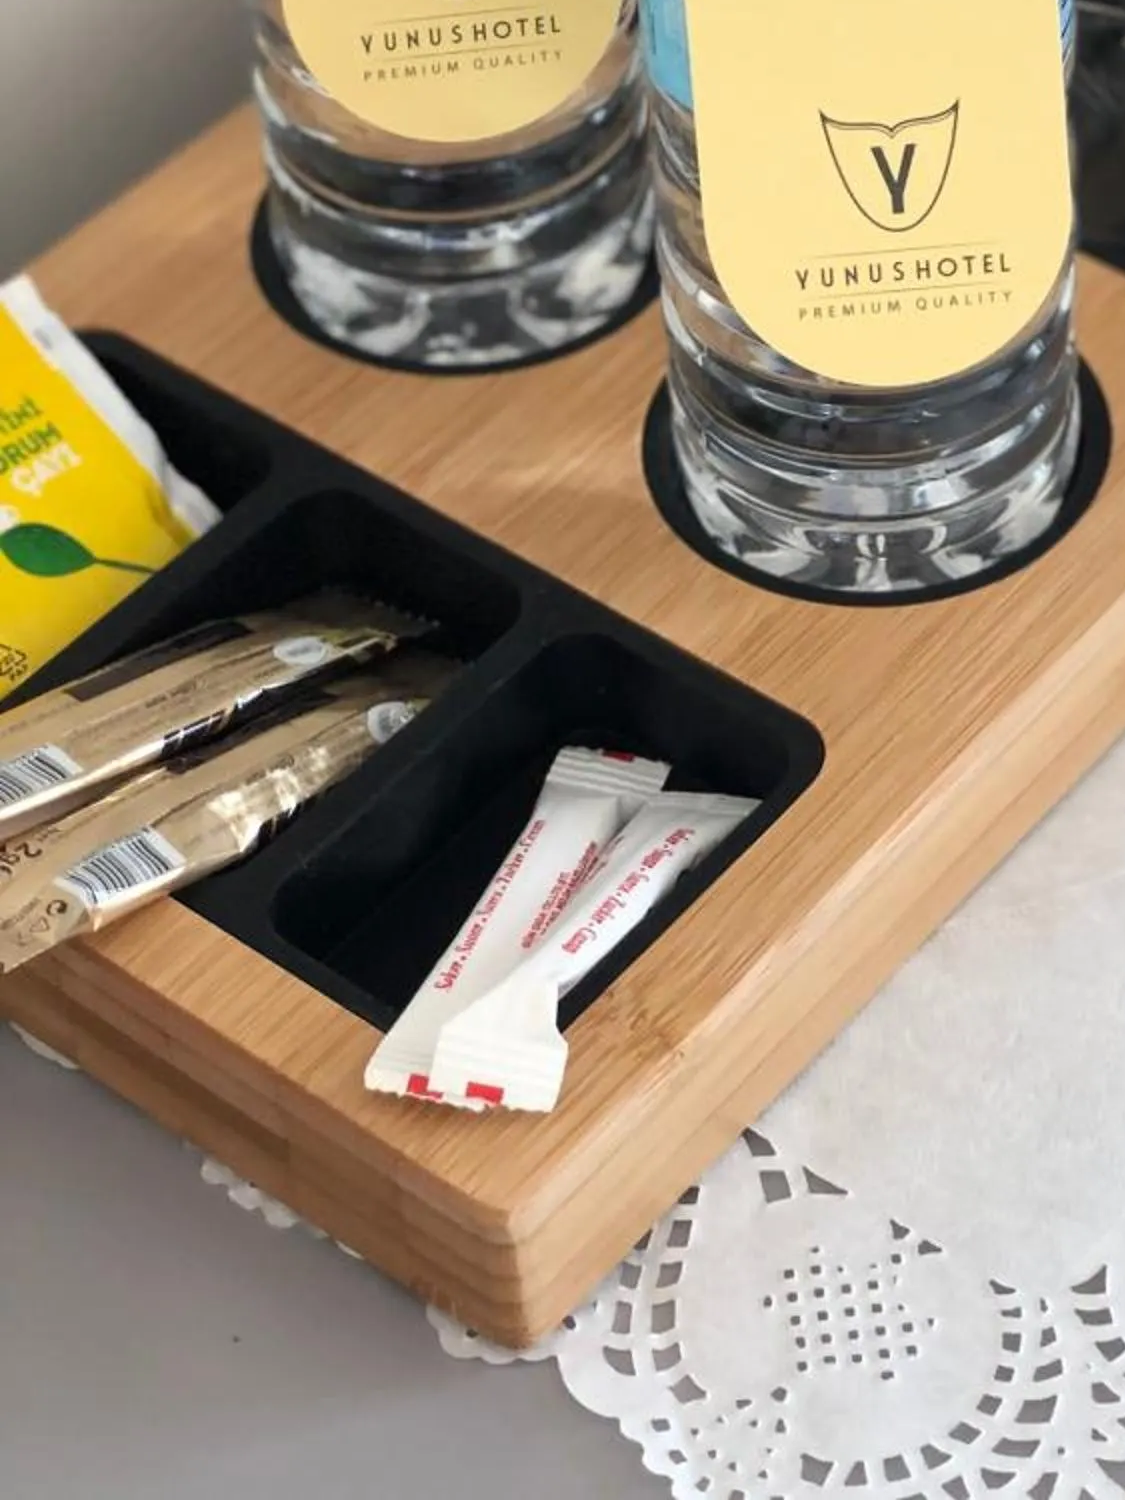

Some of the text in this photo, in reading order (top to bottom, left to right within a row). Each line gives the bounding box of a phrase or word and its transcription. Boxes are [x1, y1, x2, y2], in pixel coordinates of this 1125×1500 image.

[360, 14, 562, 54] YUNUSHOTEL
[363, 50, 563, 82] PREMIUM QUALITY
[870, 142, 917, 215] Y
[795, 252, 1012, 290] YUNUSHOTEL
[798, 290, 1013, 321] PREMIUM QUALITY
